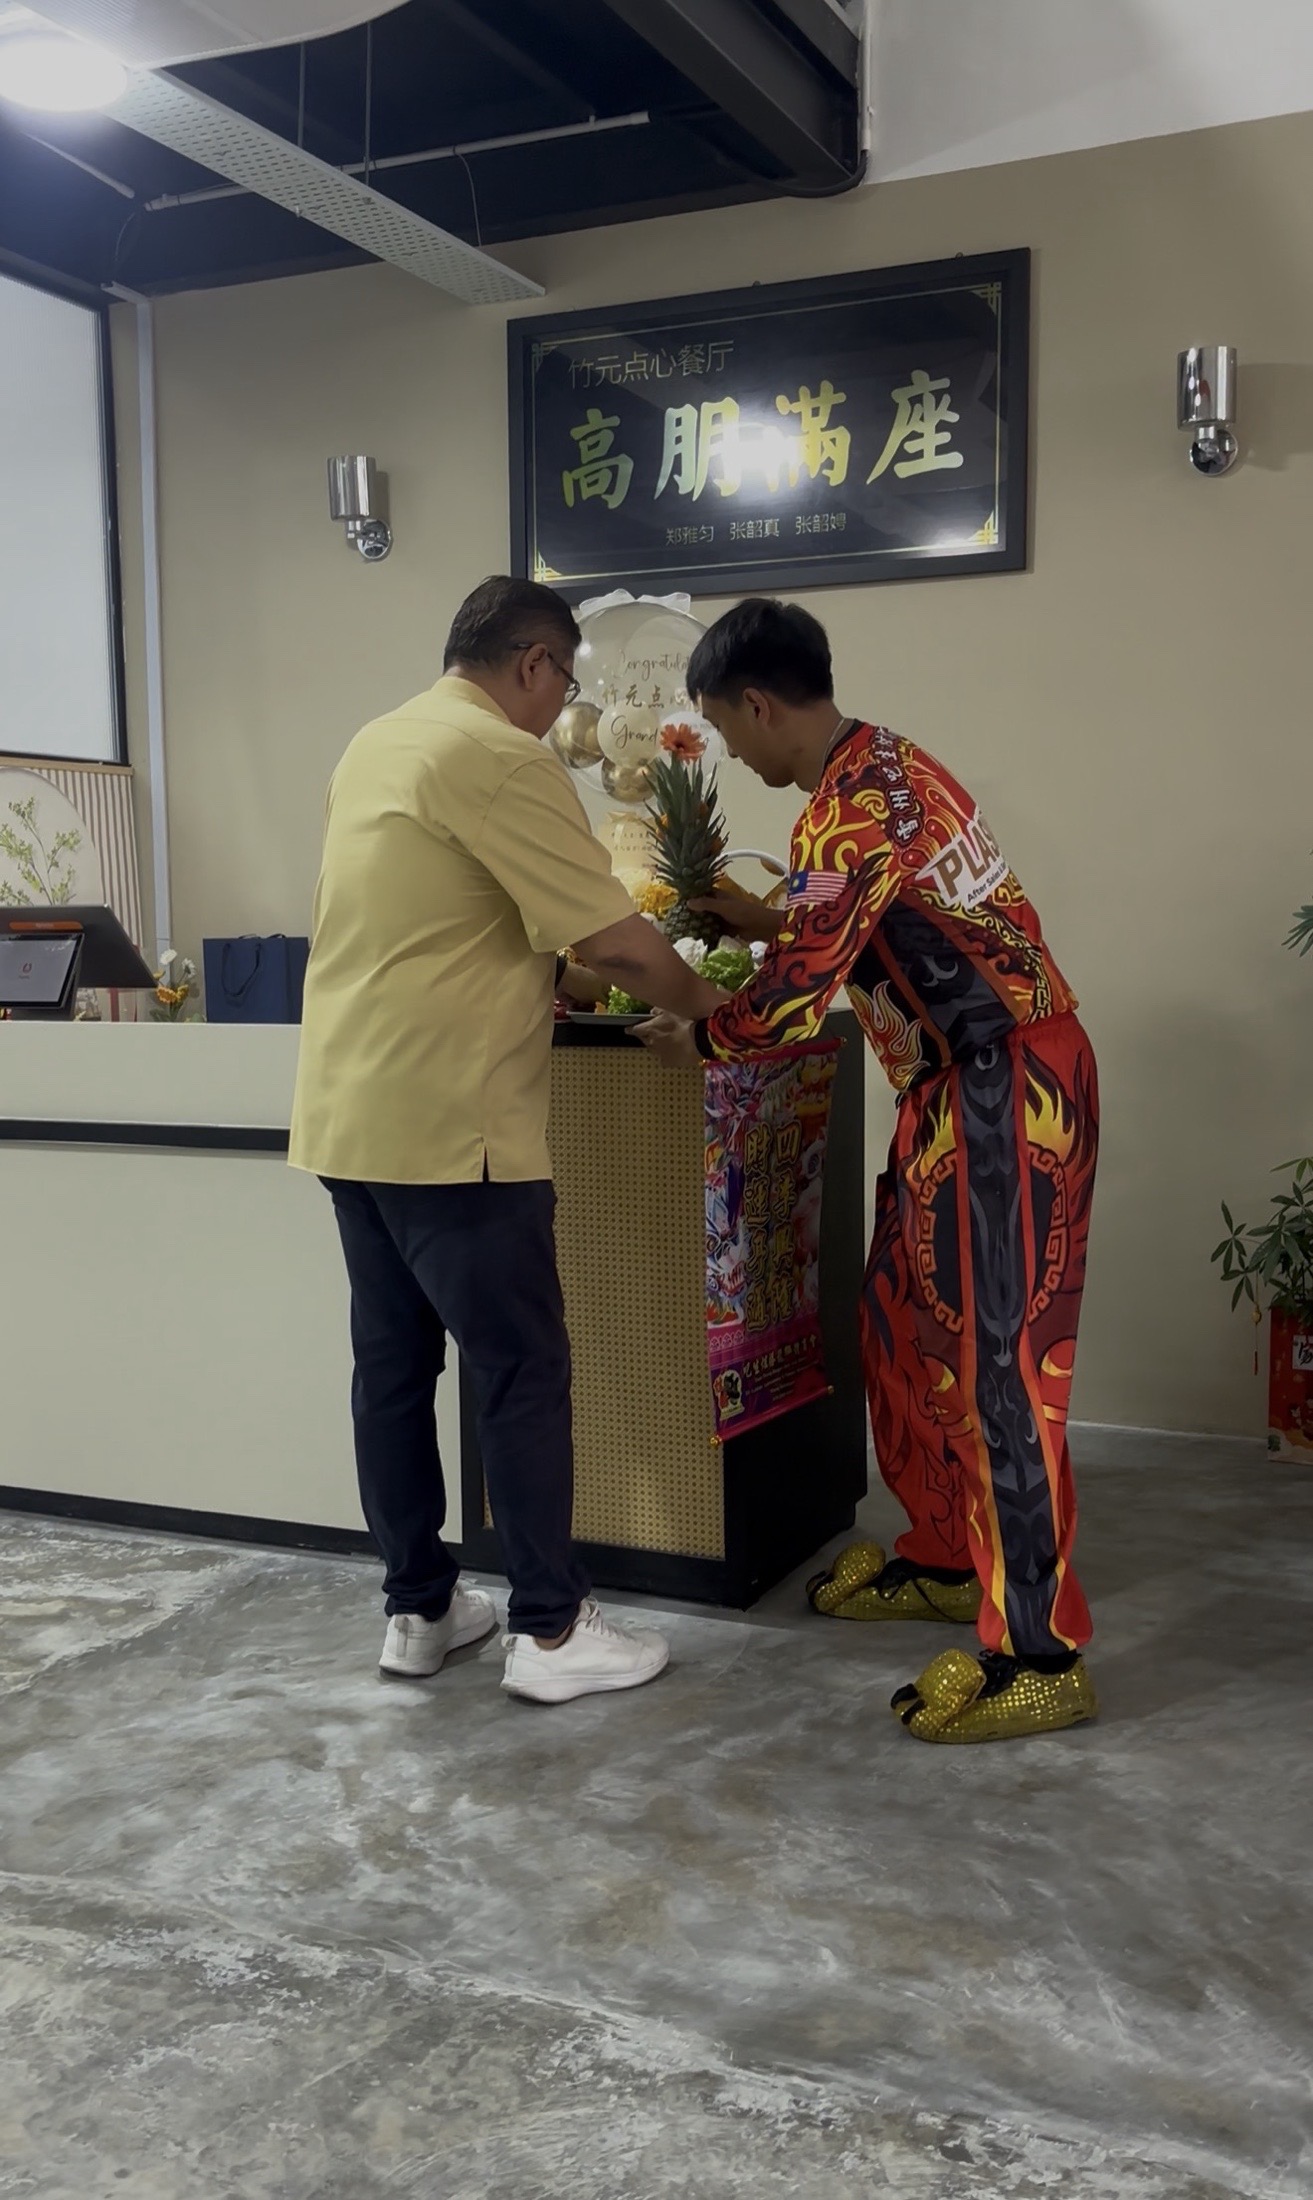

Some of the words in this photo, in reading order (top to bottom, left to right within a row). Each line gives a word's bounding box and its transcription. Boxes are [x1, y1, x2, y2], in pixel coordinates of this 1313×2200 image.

[568, 340, 734, 389] 竹元点心餐厅
[665, 524, 714, 546] 郑雅匀
[611, 715, 658, 749] Grand
[967, 884, 987, 904] After
